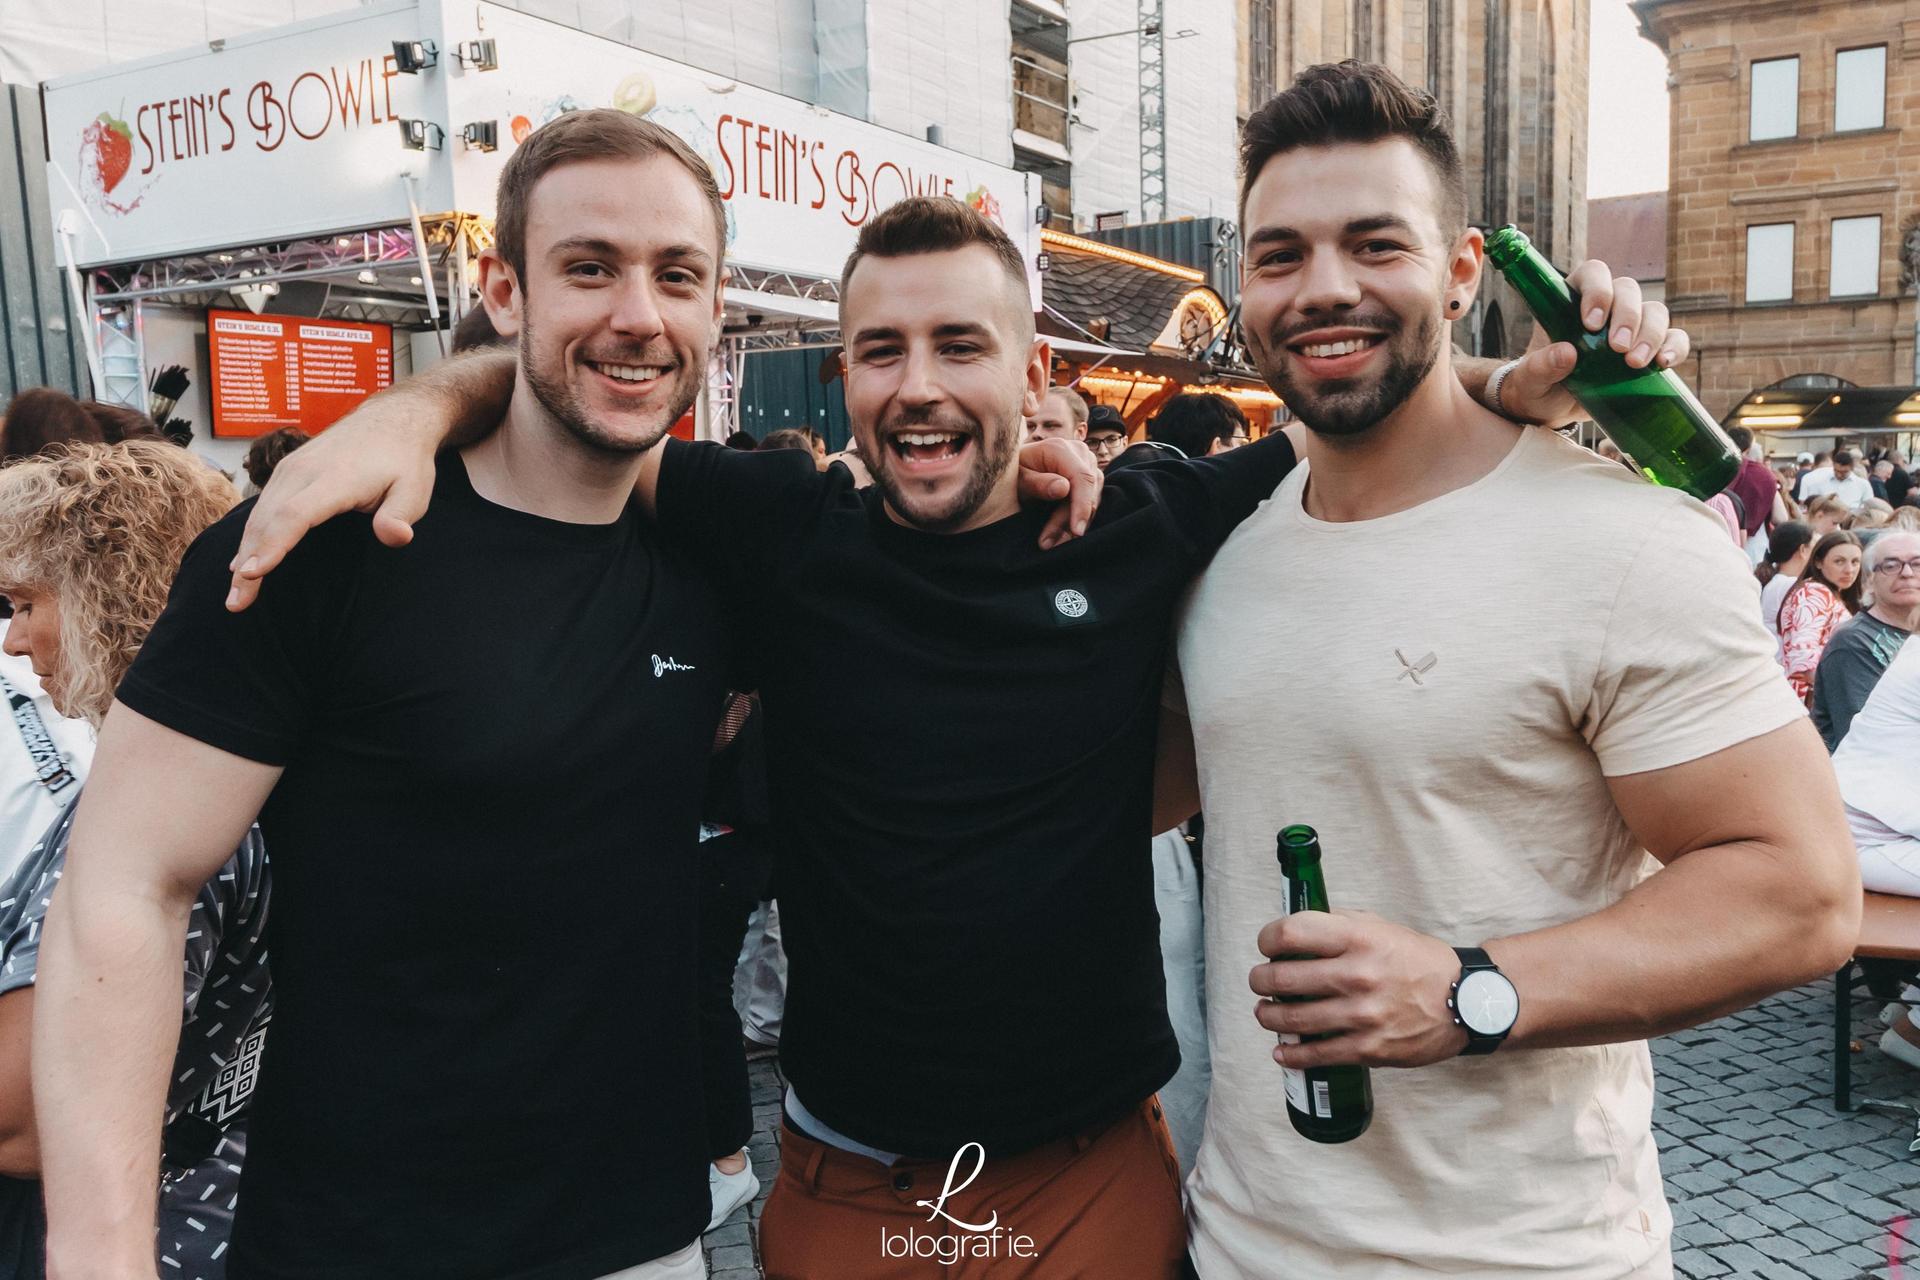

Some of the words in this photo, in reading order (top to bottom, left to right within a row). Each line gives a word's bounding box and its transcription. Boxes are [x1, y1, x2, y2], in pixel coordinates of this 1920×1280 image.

[137, 88, 235, 175] STEIN'S
[247, 54, 399, 152] BOWLE
[717, 113, 826, 210] STEIN'S
[836, 150, 954, 227] BOW
